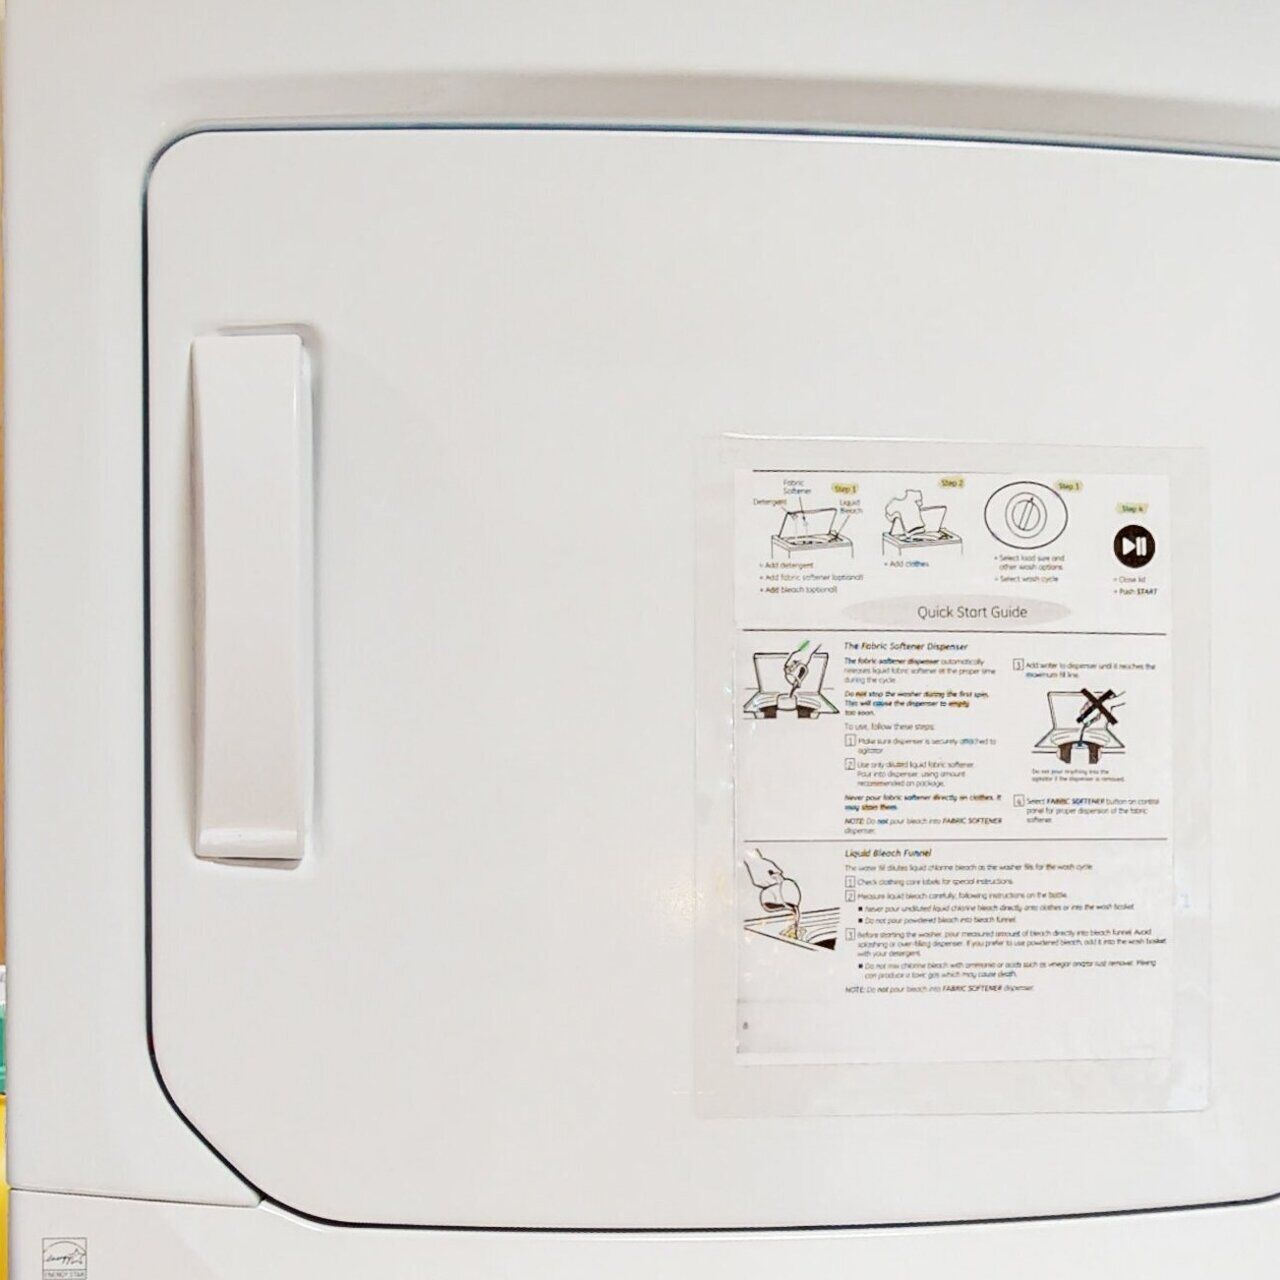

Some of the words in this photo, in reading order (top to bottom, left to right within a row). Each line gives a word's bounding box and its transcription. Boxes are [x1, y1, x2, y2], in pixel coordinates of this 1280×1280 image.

[916, 606, 955, 621] Quick
[958, 605, 988, 620] Start
[990, 604, 1028, 620] Guide
[843, 642, 859, 650] The
[861, 642, 888, 651] Fabric
[889, 642, 925, 651] Softener
[926, 642, 969, 652] Dispenser
[844, 848, 871, 859] Liquid
[873, 848, 902, 858] Bleach
[903, 848, 933, 858] Funnel
